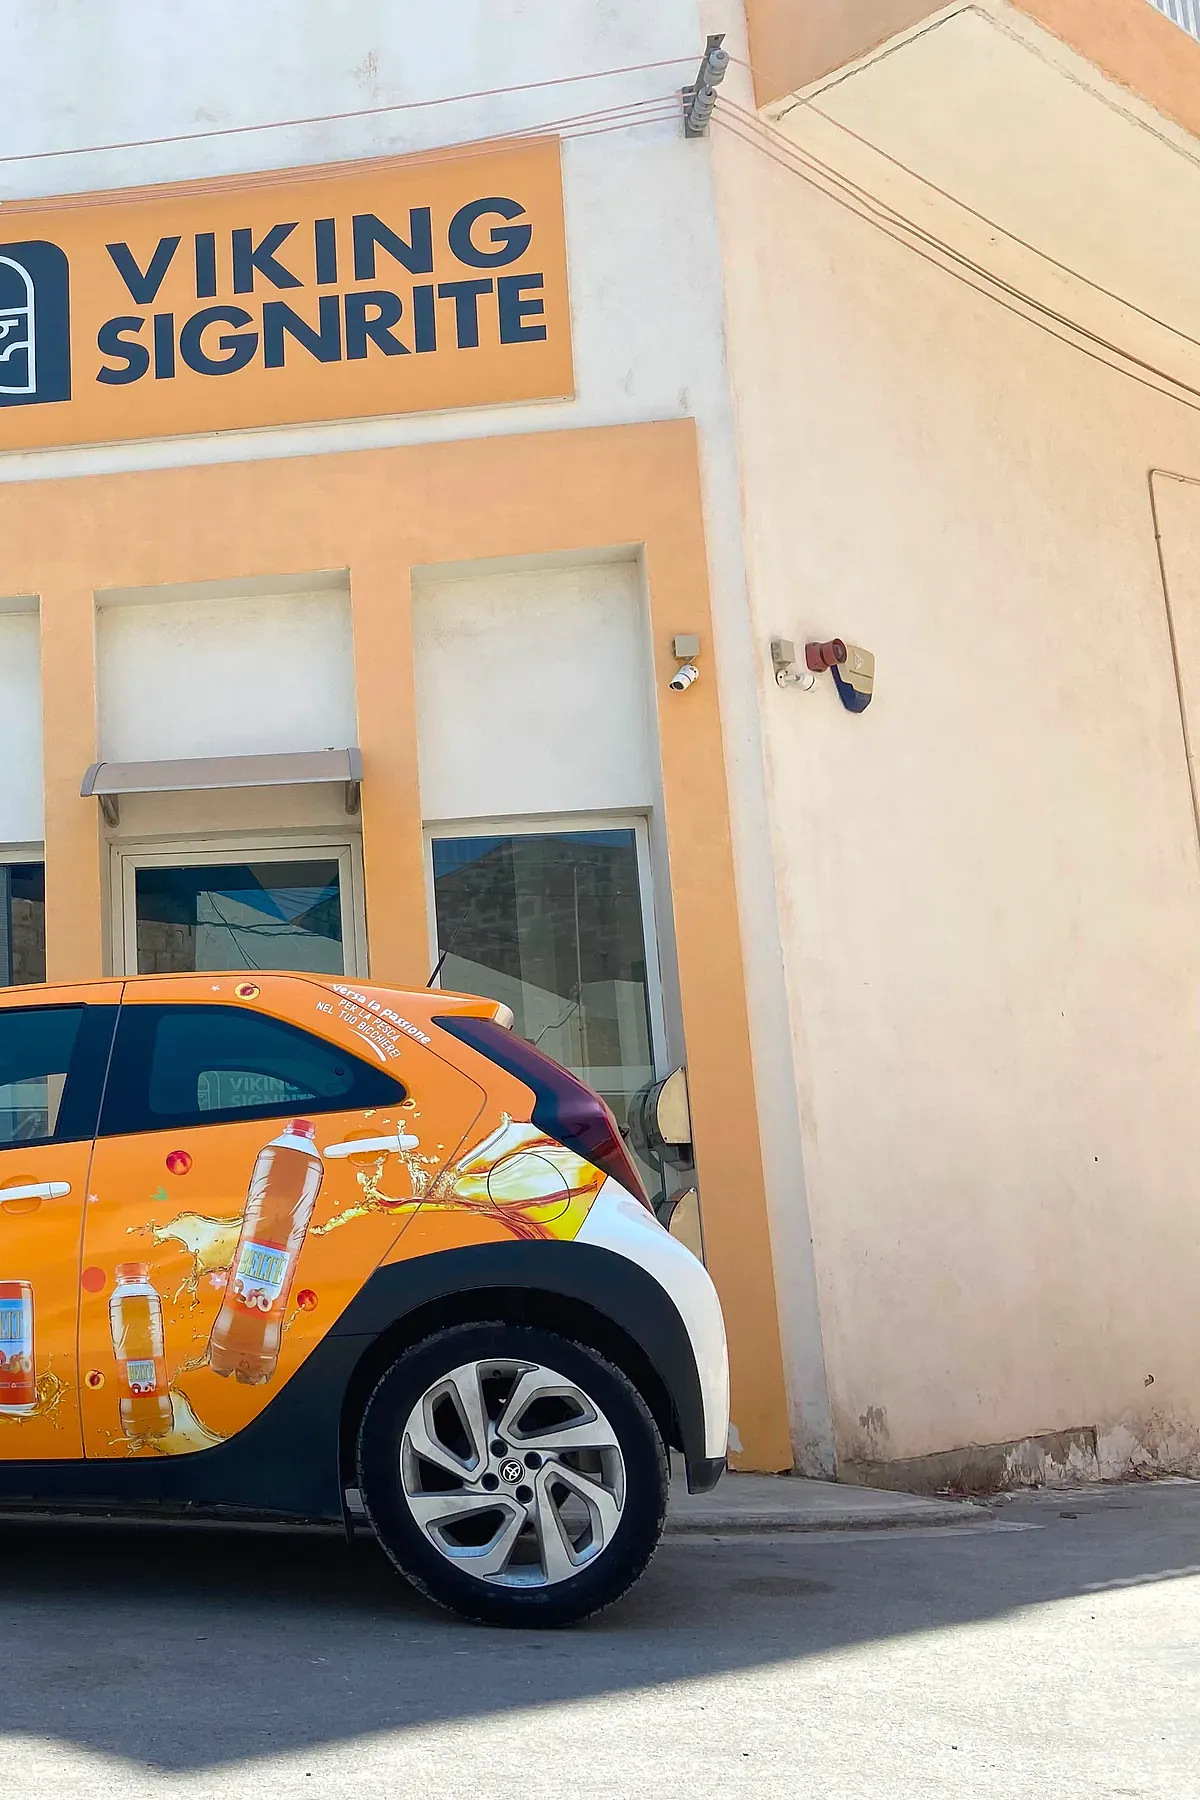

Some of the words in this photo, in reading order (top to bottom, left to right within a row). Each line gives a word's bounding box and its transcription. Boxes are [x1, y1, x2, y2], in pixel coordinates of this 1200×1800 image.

[104, 196, 532, 305] VIKING
[95, 272, 547, 386] SIGNRITE
[316, 1001, 333, 1015] NEL
[338, 1009, 358, 1024] TUO
[357, 1021, 401, 1058] BICCHIERE!
[332, 984, 367, 1003] versa
[367, 1000, 381, 1012] la
[380, 1008, 432, 1044] passione
[338, 998, 358, 1013] PER
[358, 1009, 371, 1020] LA
[372, 1017, 401, 1042] PESCA
